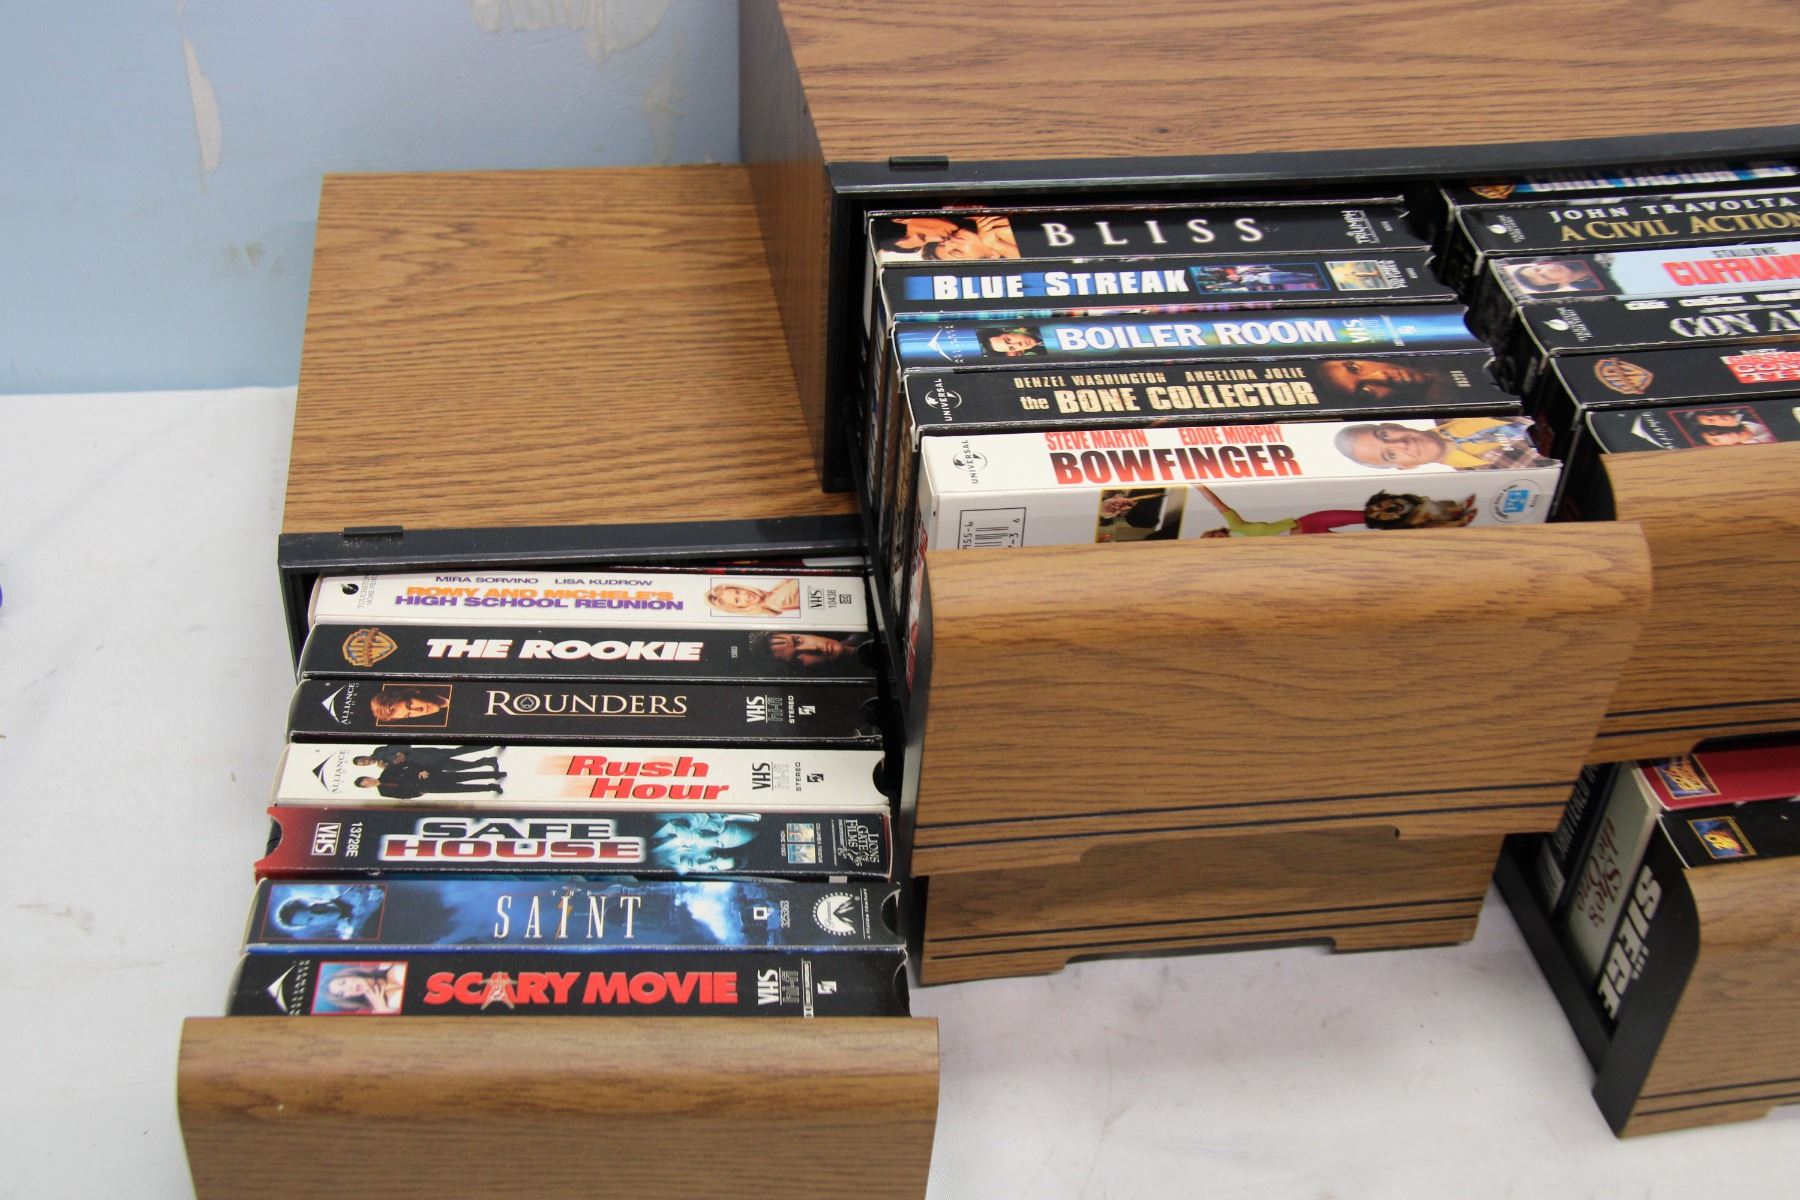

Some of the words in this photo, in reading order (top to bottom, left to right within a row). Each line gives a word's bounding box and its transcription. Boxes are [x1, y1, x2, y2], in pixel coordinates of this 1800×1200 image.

[1548, 206, 1630, 223] JOHN
[1641, 196, 1799, 215] TRAVOLTA
[1560, 225, 1586, 242] A
[1584, 219, 1679, 240] CIVIL
[933, 275, 1024, 300] BLUE
[1044, 270, 1190, 297] STREAK
[1056, 323, 1207, 352] BOILER
[1212, 320, 1338, 347] ROOM
[1669, 313, 1759, 338] CON
[1014, 376, 1067, 389] DENZEL
[1071, 372, 1167, 387] WASHINGTON
[1185, 367, 1257, 383] ANGELINA
[1264, 367, 1305, 379] JOLIE
[932, 377, 953, 422] UNIVERSAL
[1020, 395, 1049, 411] the
[1054, 387, 1141, 414] BONE
[1146, 382, 1320, 410] COLLECTOR
[1044, 430, 1090, 451] STEVE
[1091, 428, 1149, 449] MARTIN
[1178, 426, 1223, 446] EDDIE
[1223, 424, 1286, 445] MURPHY
[963, 439, 980, 485] UNIVERSAL
[1049, 444, 1304, 485] BOWFINGER
[407, 586, 478, 597] ROMY
[484, 587, 542, 598] AND
[544, 588, 675, 600] MICHELE'S
[475, 577, 539, 585] SORVINO
[395, 596, 459, 606] HIGH
[463, 597, 570, 608] SCHOOL
[574, 598, 684, 611] REUNION
[808, 589, 825, 609] VHS
[426, 638, 513, 659] THE
[518, 639, 704, 662] ROOKIE
[340, 682, 355, 725] ALLIANCE
[484, 689, 688, 716] ROUNDERS
[746, 695, 766, 723] VHS
[788, 695, 796, 724] STEREO
[331, 749, 346, 793] ALLIANCE
[566, 755, 710, 778] Rush
[751, 762, 771, 791] VHS
[589, 777, 729, 800] Hour
[313, 823, 341, 856] VHS
[345, 821, 363, 857] 13728E
[418, 818, 617, 840] SAFE
[845, 818, 858, 848] FILMS
[856, 825, 869, 851] GATE
[380, 836, 645, 862] HOUSE
[867, 833, 880, 863] LIONS
[494, 895, 642, 939] SAINT
[1597, 864, 1663, 1020] SIEGE
[424, 971, 582, 1009] SCARY
[582, 970, 738, 1004] MOVIE
[757, 968, 779, 1005] VHS
